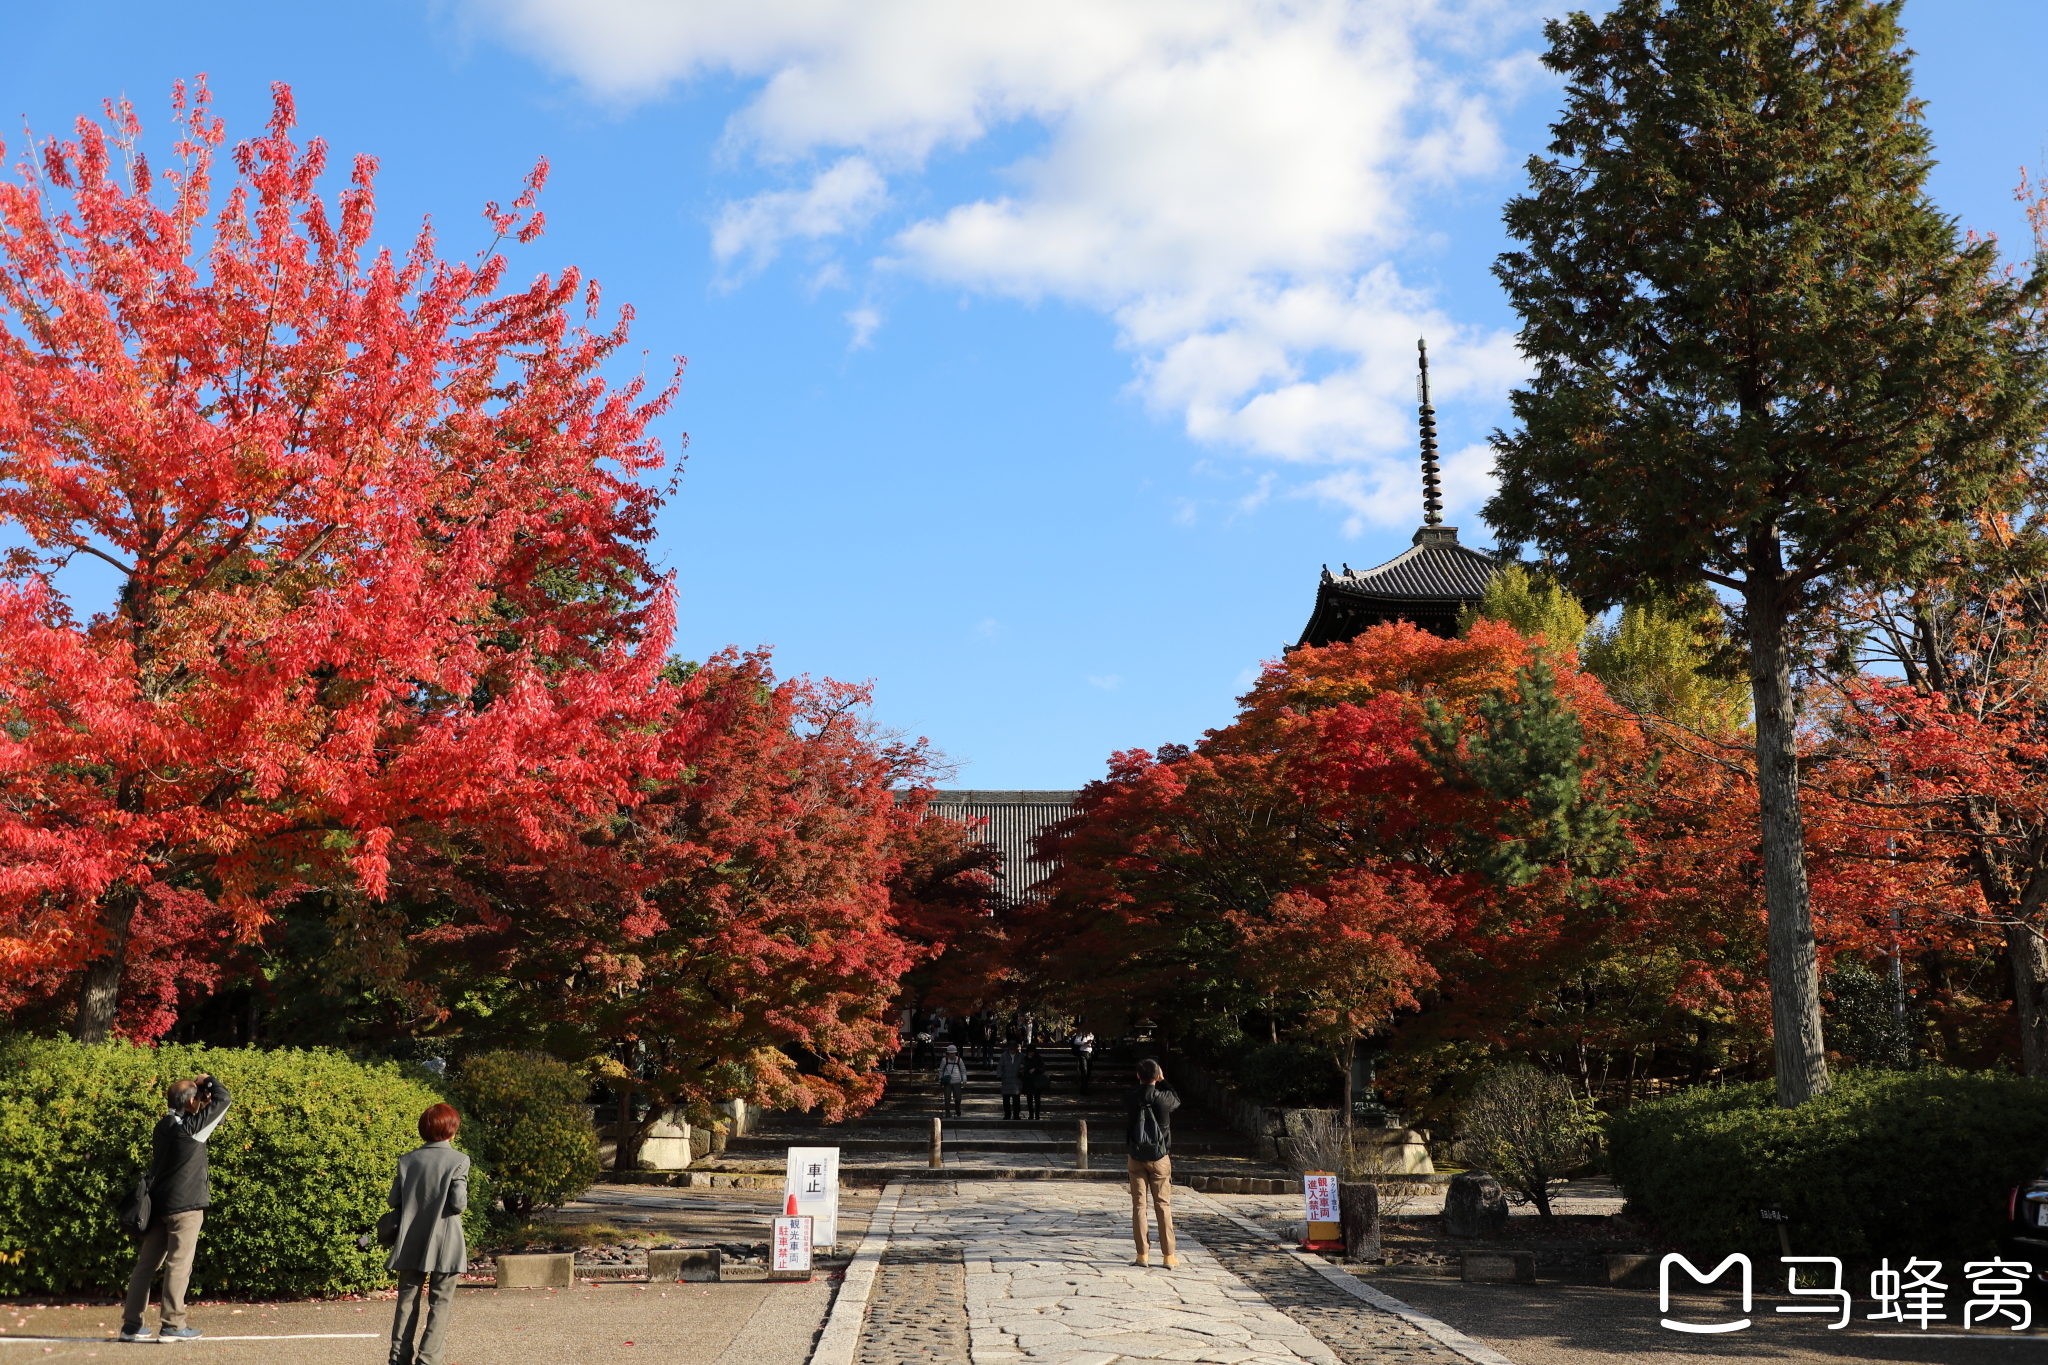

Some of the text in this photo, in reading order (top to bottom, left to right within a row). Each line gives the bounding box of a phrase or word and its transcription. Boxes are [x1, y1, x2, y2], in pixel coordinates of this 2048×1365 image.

[806, 1163, 822, 1193] 車止
[1317, 1176, 1330, 1218] 観光車両
[1307, 1179, 1320, 1221] 進入禁止
[778, 1225, 789, 1269] 駐車禁止
[789, 1219, 800, 1264] 観光車両
